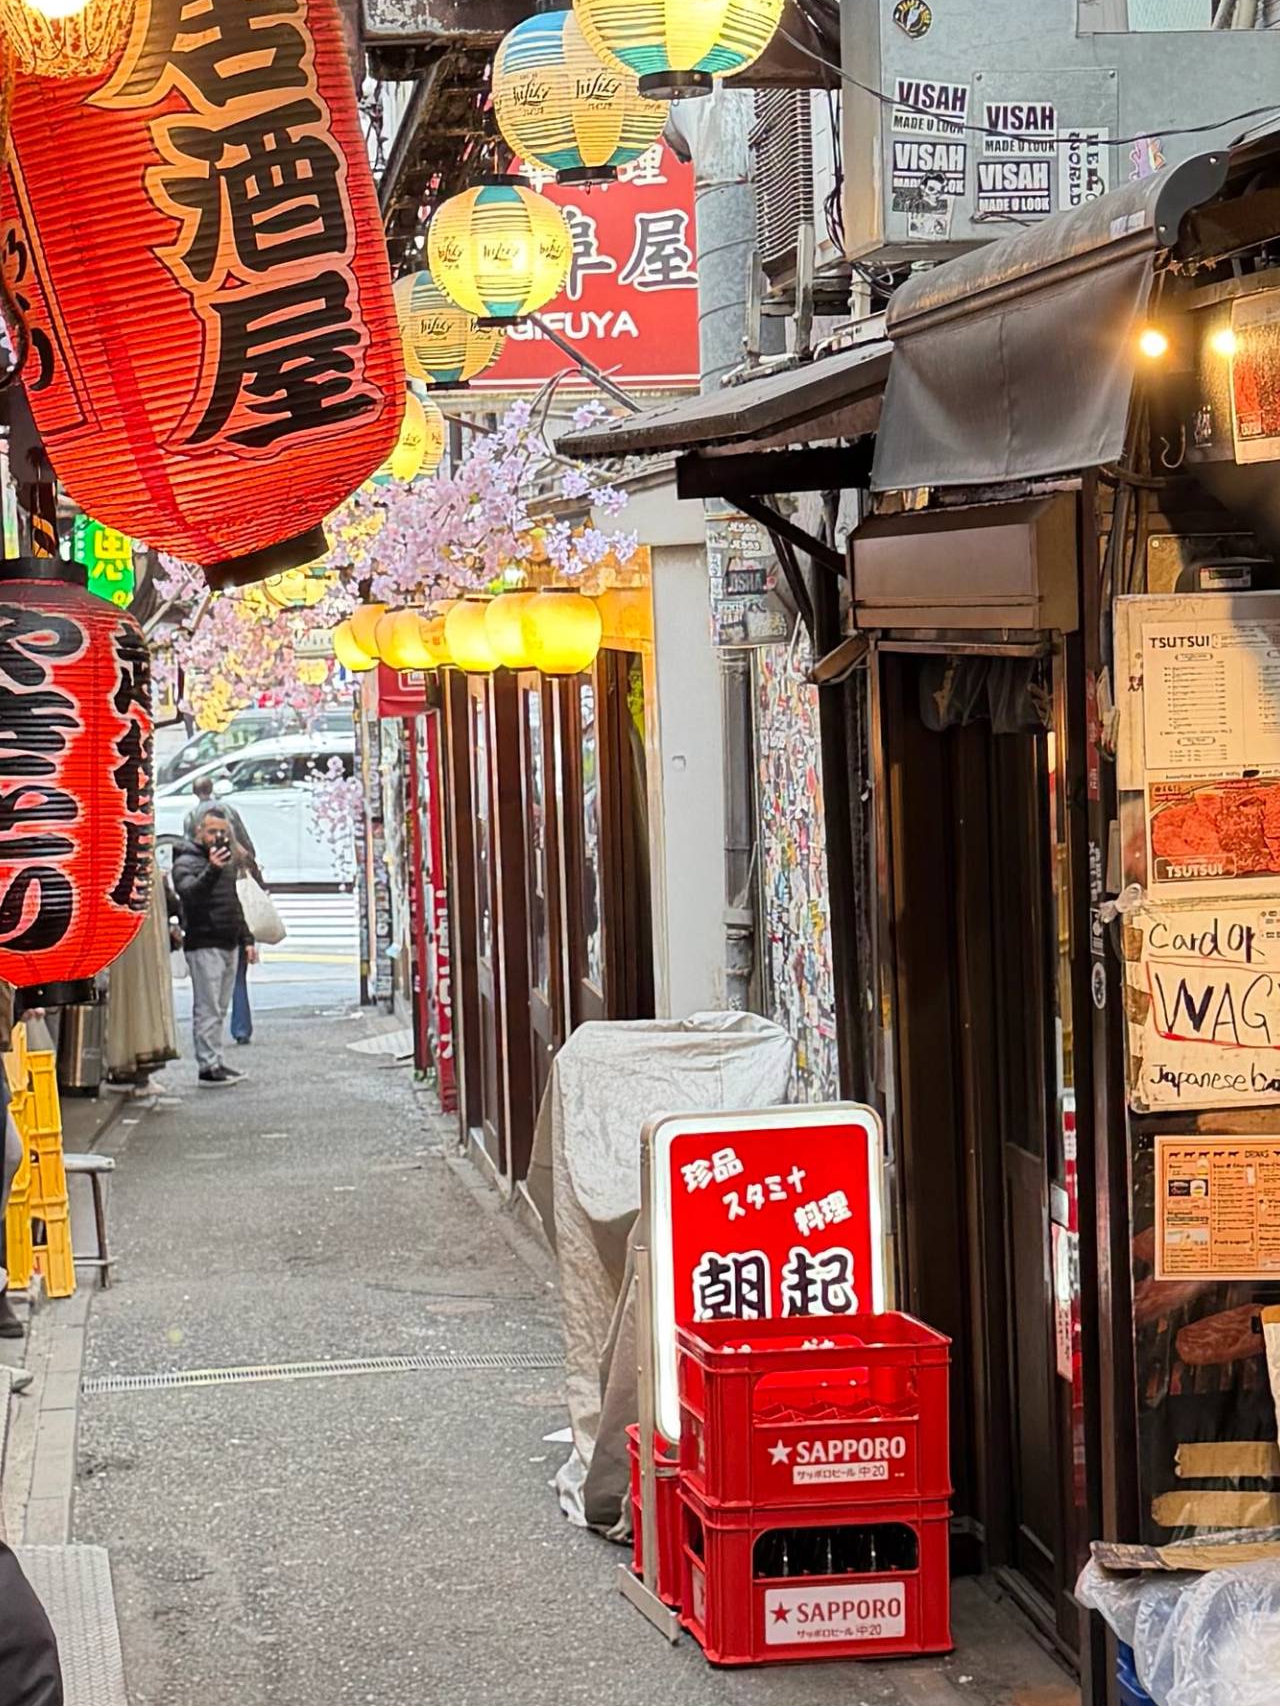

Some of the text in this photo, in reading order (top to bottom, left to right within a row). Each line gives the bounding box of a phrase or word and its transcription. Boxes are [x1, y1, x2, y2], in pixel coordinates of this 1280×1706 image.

[898, 81, 967, 112] VISAH
[894, 115, 924, 130] MADE
[985, 105, 1055, 131] VISAH
[894, 142, 965, 172] VISAH
[984, 140, 1016, 153] MADE
[978, 162, 1049, 191] VISAH
[978, 196, 1050, 212] MADE U LOOK
[1149, 635, 1210, 649] TSUTSUI
[1149, 918, 1227, 958] Card
[1149, 1063, 1247, 1097] Japanese
[680, 1147, 745, 1194] 珍品
[721, 1165, 808, 1221] スタミナ
[792, 1190, 853, 1237] 料理
[691, 1247, 859, 1321] 朝起
[796, 1436, 907, 1464] SAPPORO
[796, 1597, 902, 1624] SAPPORO
